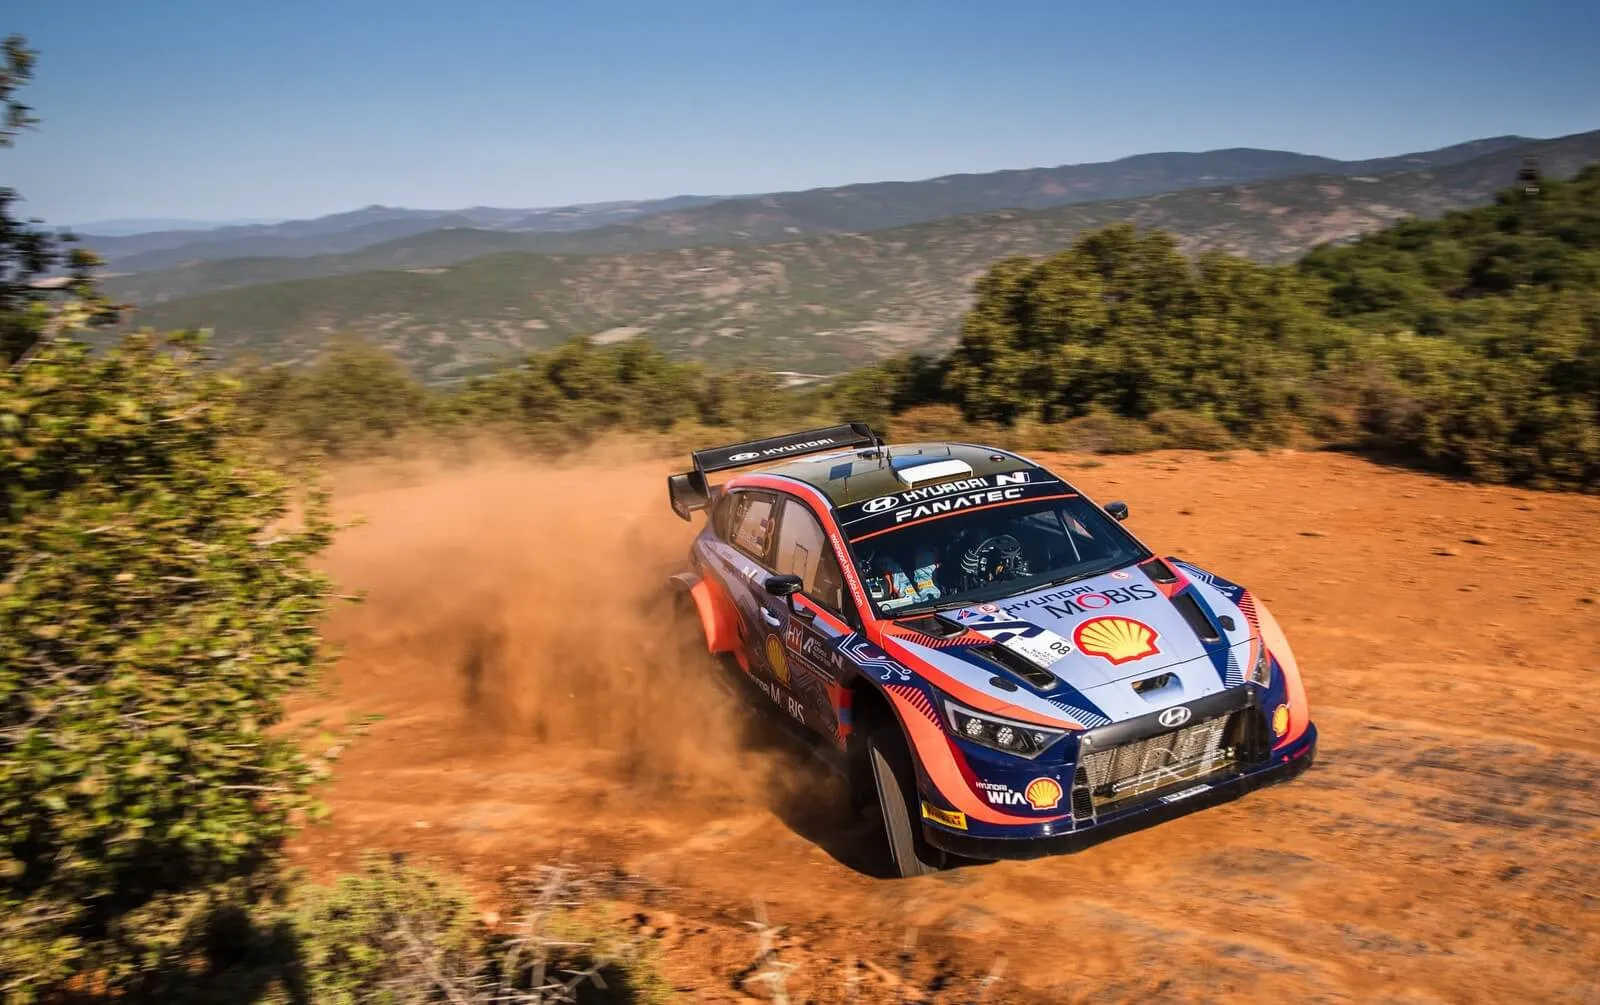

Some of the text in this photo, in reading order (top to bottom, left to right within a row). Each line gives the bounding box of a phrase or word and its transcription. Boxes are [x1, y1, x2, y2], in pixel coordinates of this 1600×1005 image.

[763, 438, 835, 455] HYUNDAI
[902, 477, 988, 501] HYUNDAI
[896, 488, 1022, 522] FANATEC
[1002, 585, 1096, 619] HYUNDAI
[1042, 584, 1158, 619] MOBIS
[1050, 641, 1071, 655] 08
